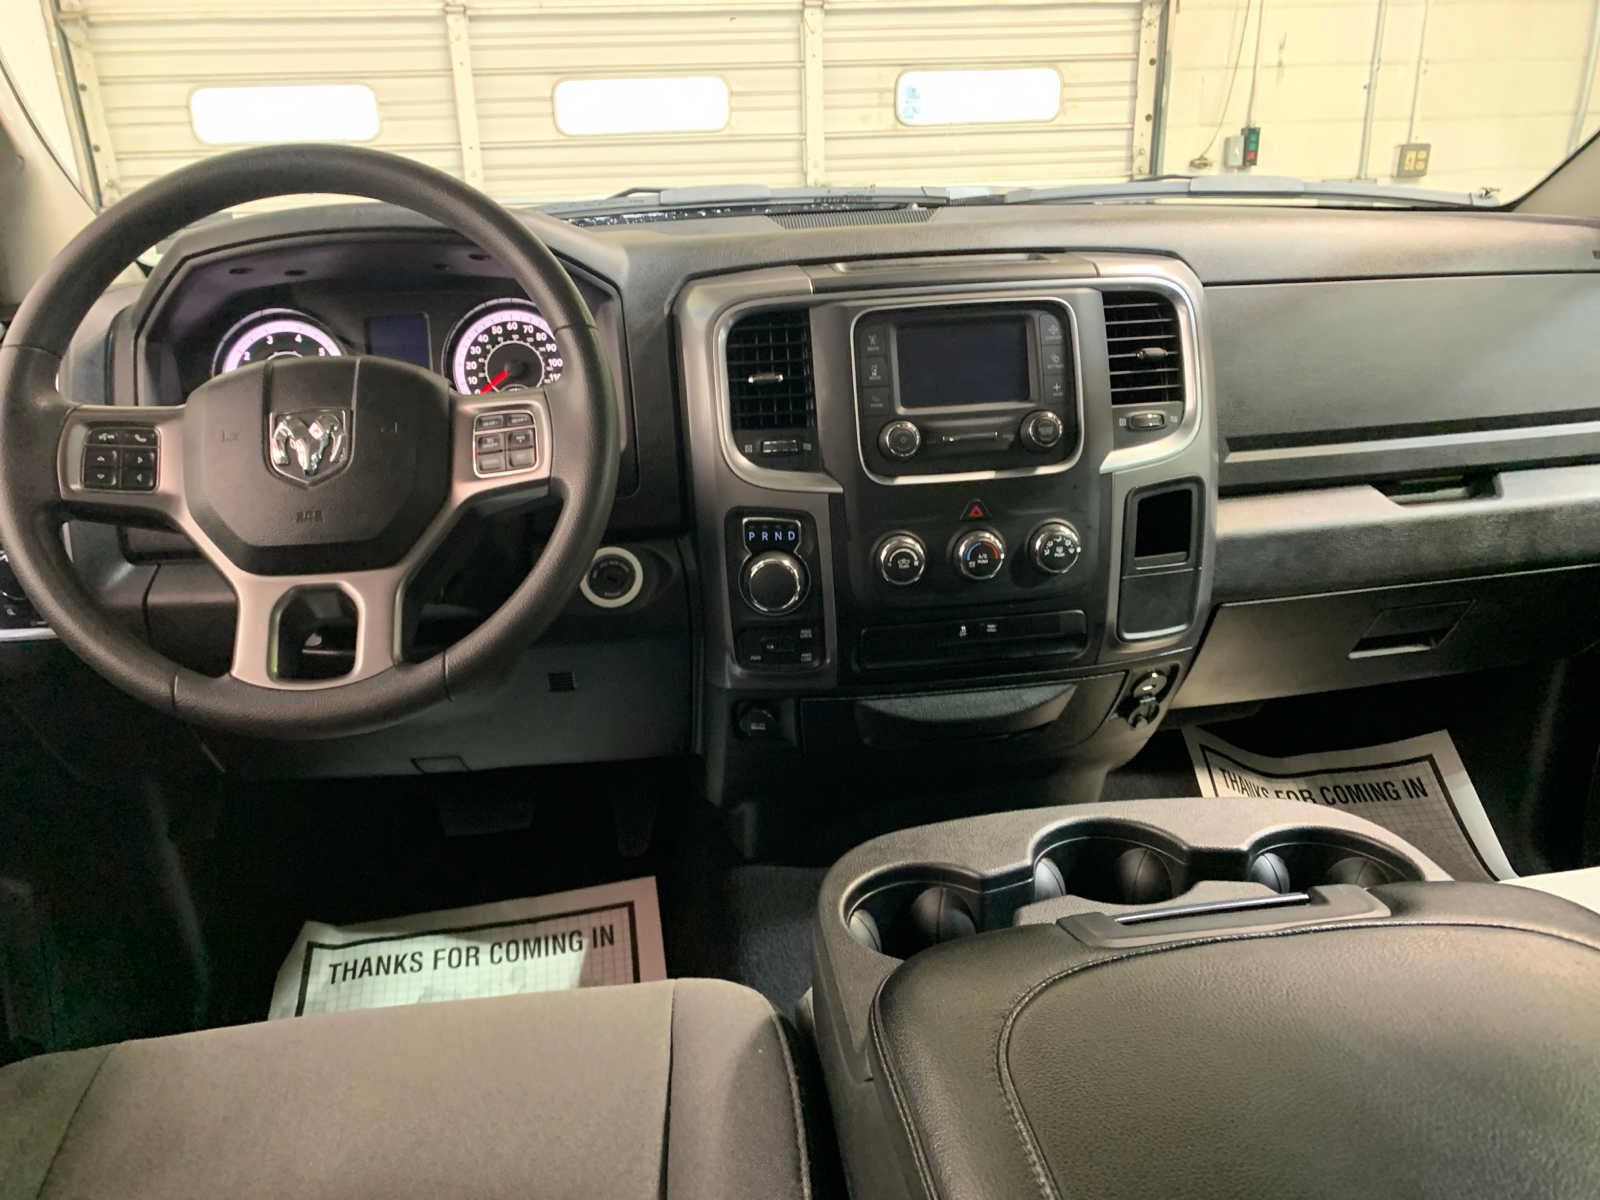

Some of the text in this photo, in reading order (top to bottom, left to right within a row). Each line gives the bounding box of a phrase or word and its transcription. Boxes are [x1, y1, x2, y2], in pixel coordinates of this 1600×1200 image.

[491, 325, 503, 335] 50
[506, 322, 518, 331] 60
[523, 325, 534, 334] 70
[266, 335, 274, 345] 3
[294, 333, 302, 343] 4
[477, 334, 489, 343] 40
[535, 332, 547, 341] 80
[470, 346, 481, 355] 30
[545, 343, 557, 352] 90
[466, 361, 477, 370] 20
[548, 358, 563, 367] 100
[467, 376, 478, 385] 10
[748, 530, 796, 541] P R N D
[1319, 780, 1401, 806] COMING
[1401, 776, 1429, 799] IN
[328, 924, 615, 985] THANKS FOR COMING IN
